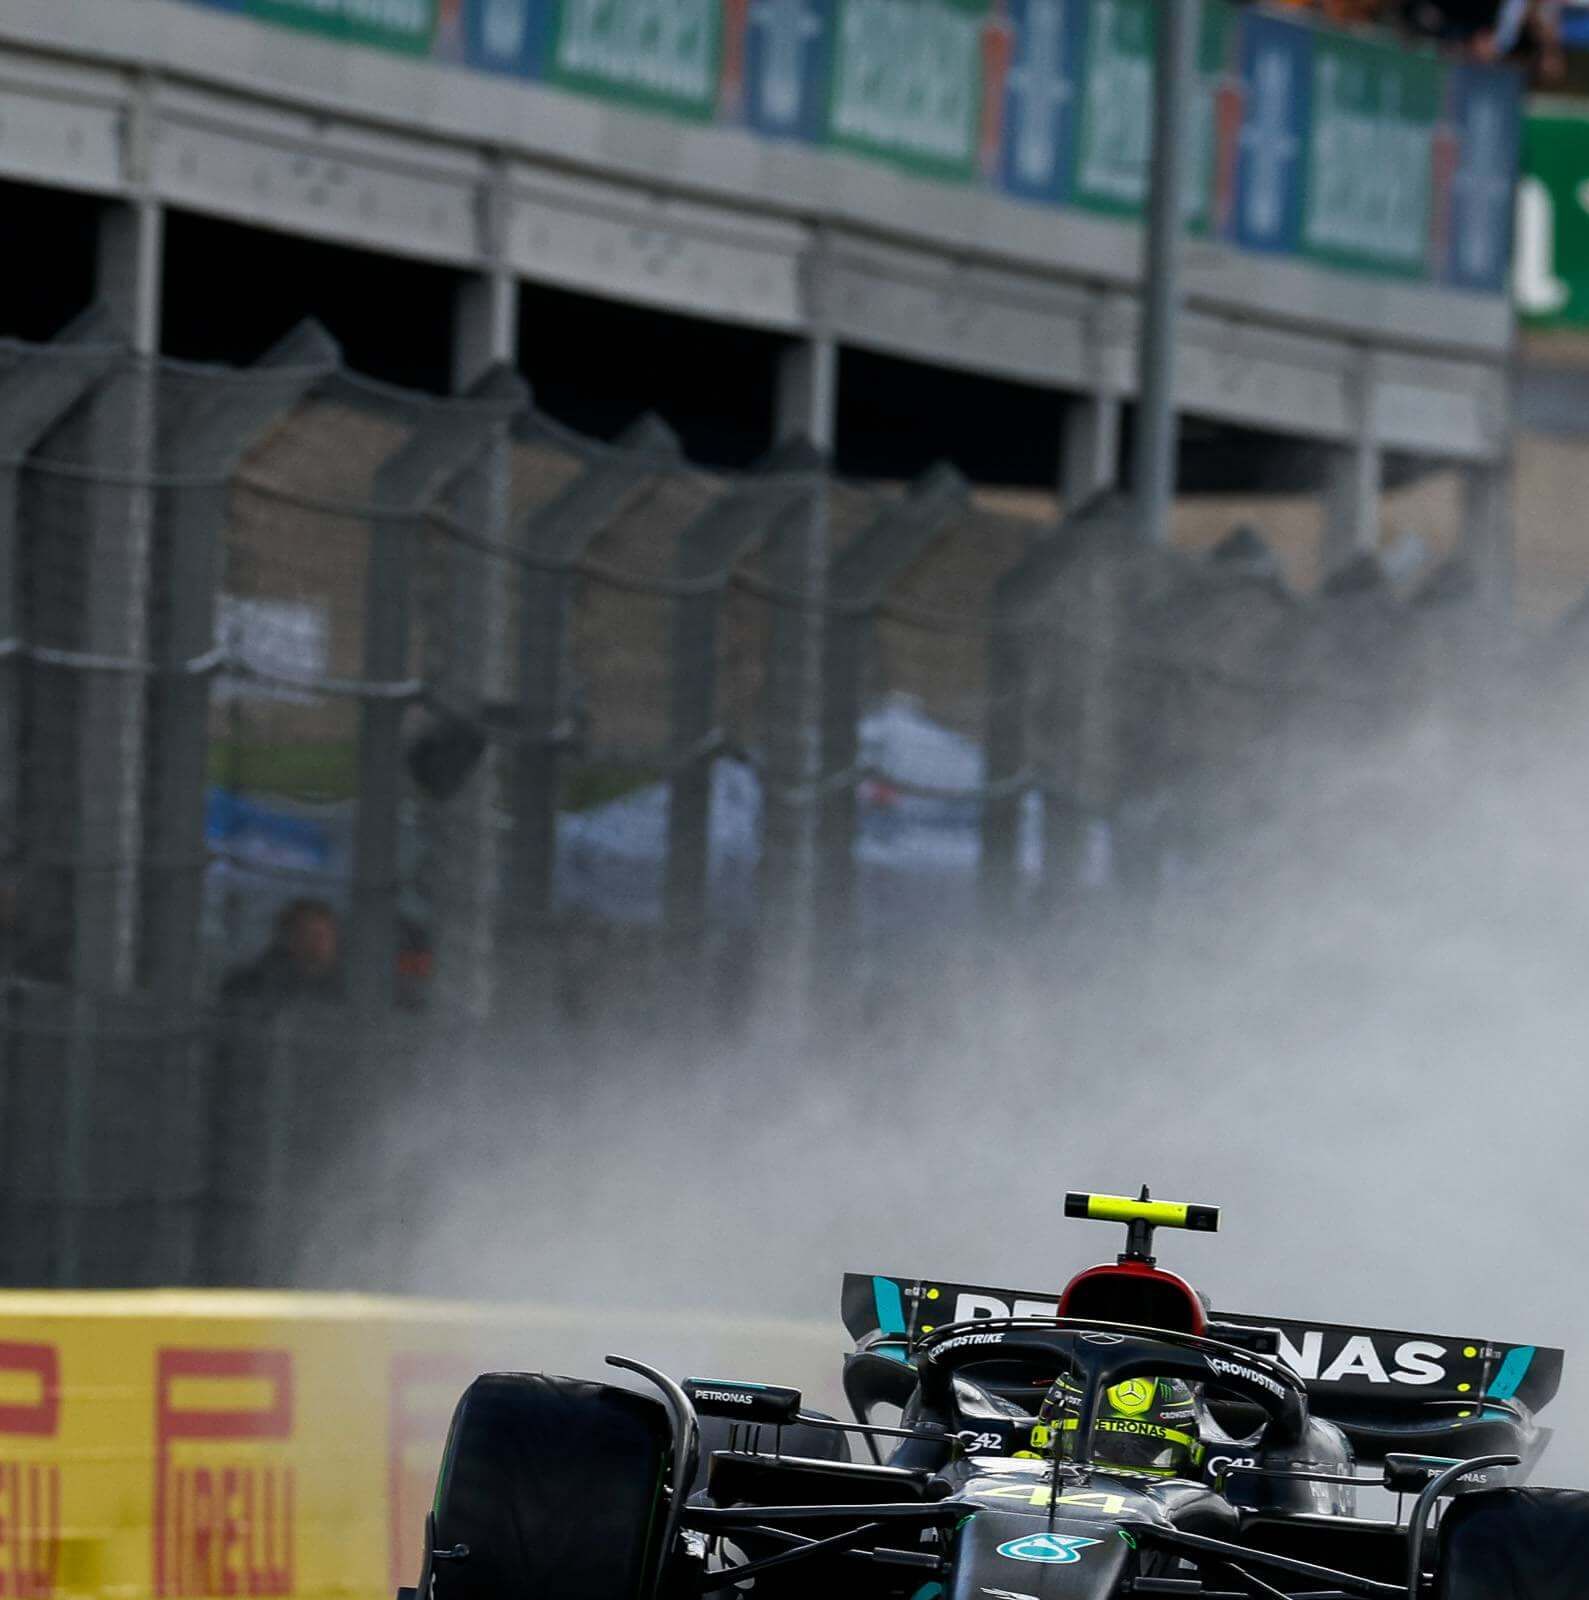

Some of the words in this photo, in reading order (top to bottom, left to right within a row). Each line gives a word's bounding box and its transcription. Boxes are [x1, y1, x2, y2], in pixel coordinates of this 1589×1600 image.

[1211, 1356, 1285, 1400] CROWDSTRIKE
[694, 1390, 753, 1405] PETRONAS
[1096, 1418, 1167, 1439] ETRONAS
[973, 1484, 1137, 1514] 44
